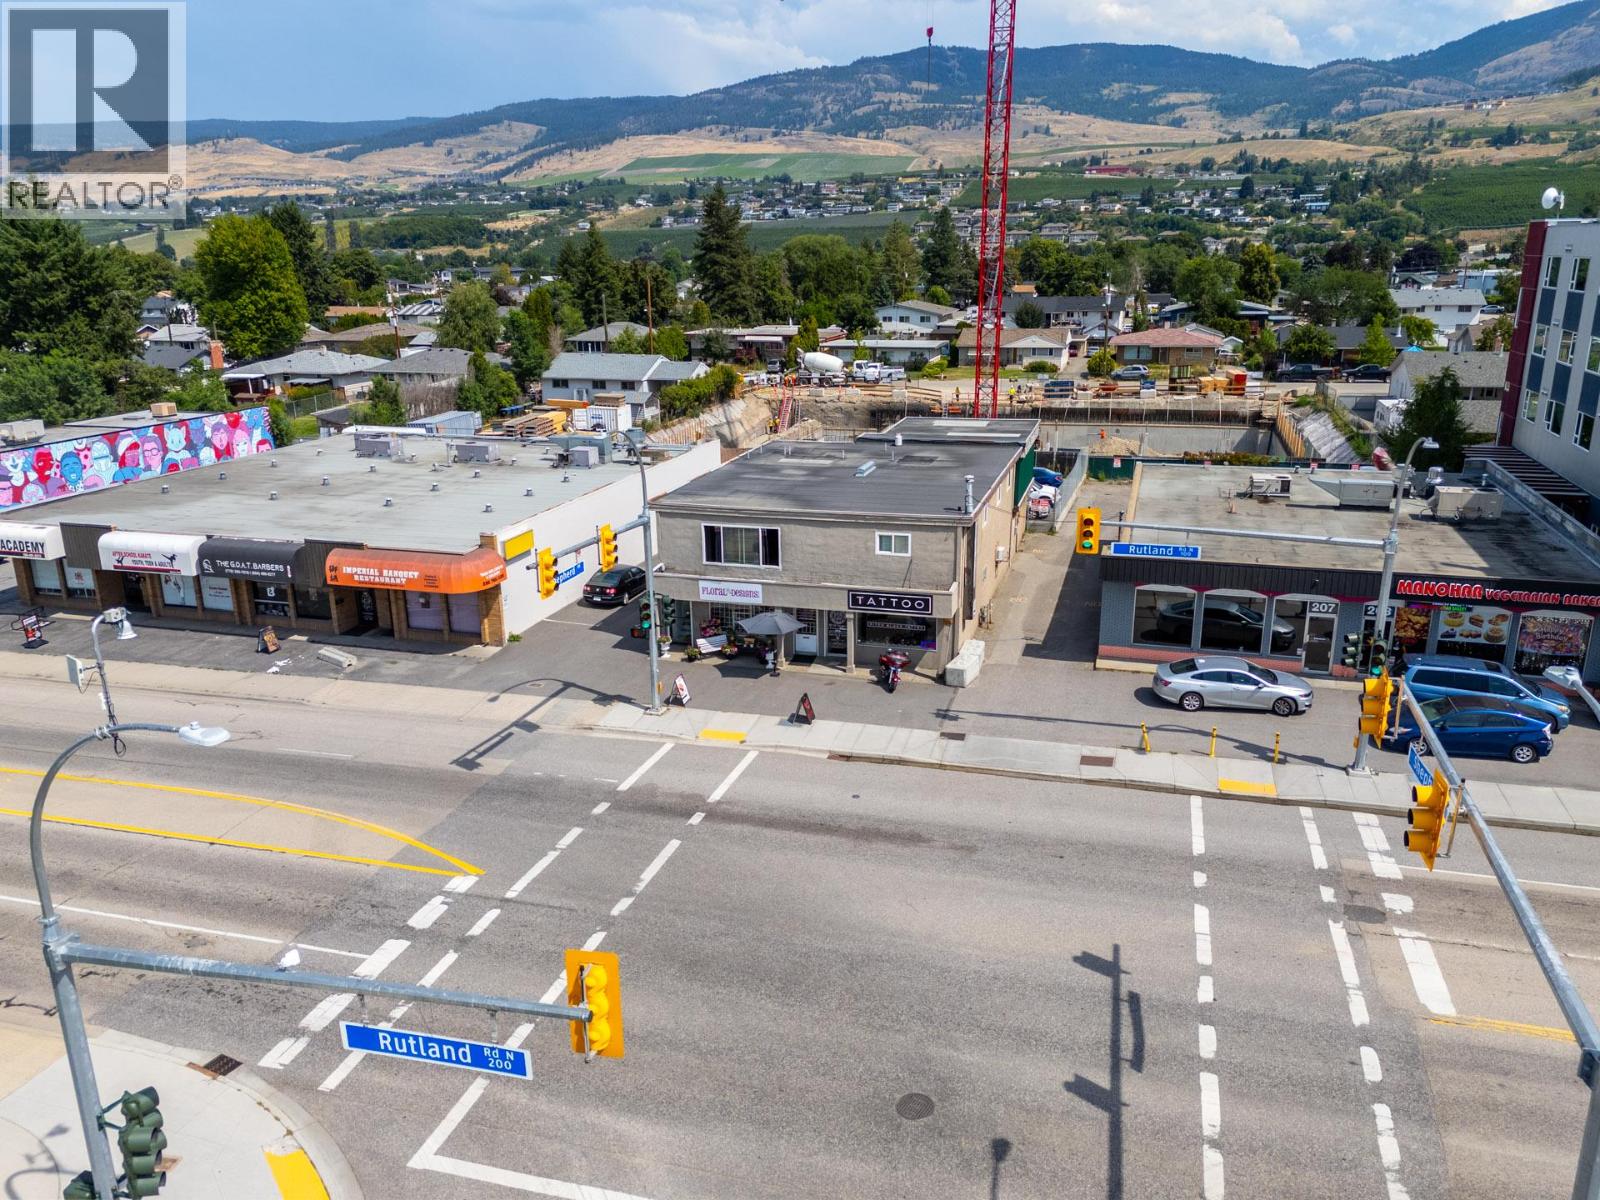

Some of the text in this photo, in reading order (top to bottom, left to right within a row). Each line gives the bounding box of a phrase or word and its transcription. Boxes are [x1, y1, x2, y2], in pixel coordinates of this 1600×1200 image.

[0, 539, 45, 553] ACADEMY
[1129, 545, 1173, 556] Rutland
[215, 560, 229, 568] THE
[253, 562, 284, 572] BARBERS
[342, 566, 380, 576] IMPERIAL
[382, 569, 419, 579] BANQUET
[353, 574, 407, 584] RESTAURANT
[1396, 579, 1483, 600] MANOHAR
[1485, 588, 1561, 605] VEGETARIAN
[856, 595, 925, 609] TATTOO
[1311, 602, 1336, 612] 207
[378, 1031, 515, 1064] Rutland Rd N
[488, 1058, 512, 1070] 200
